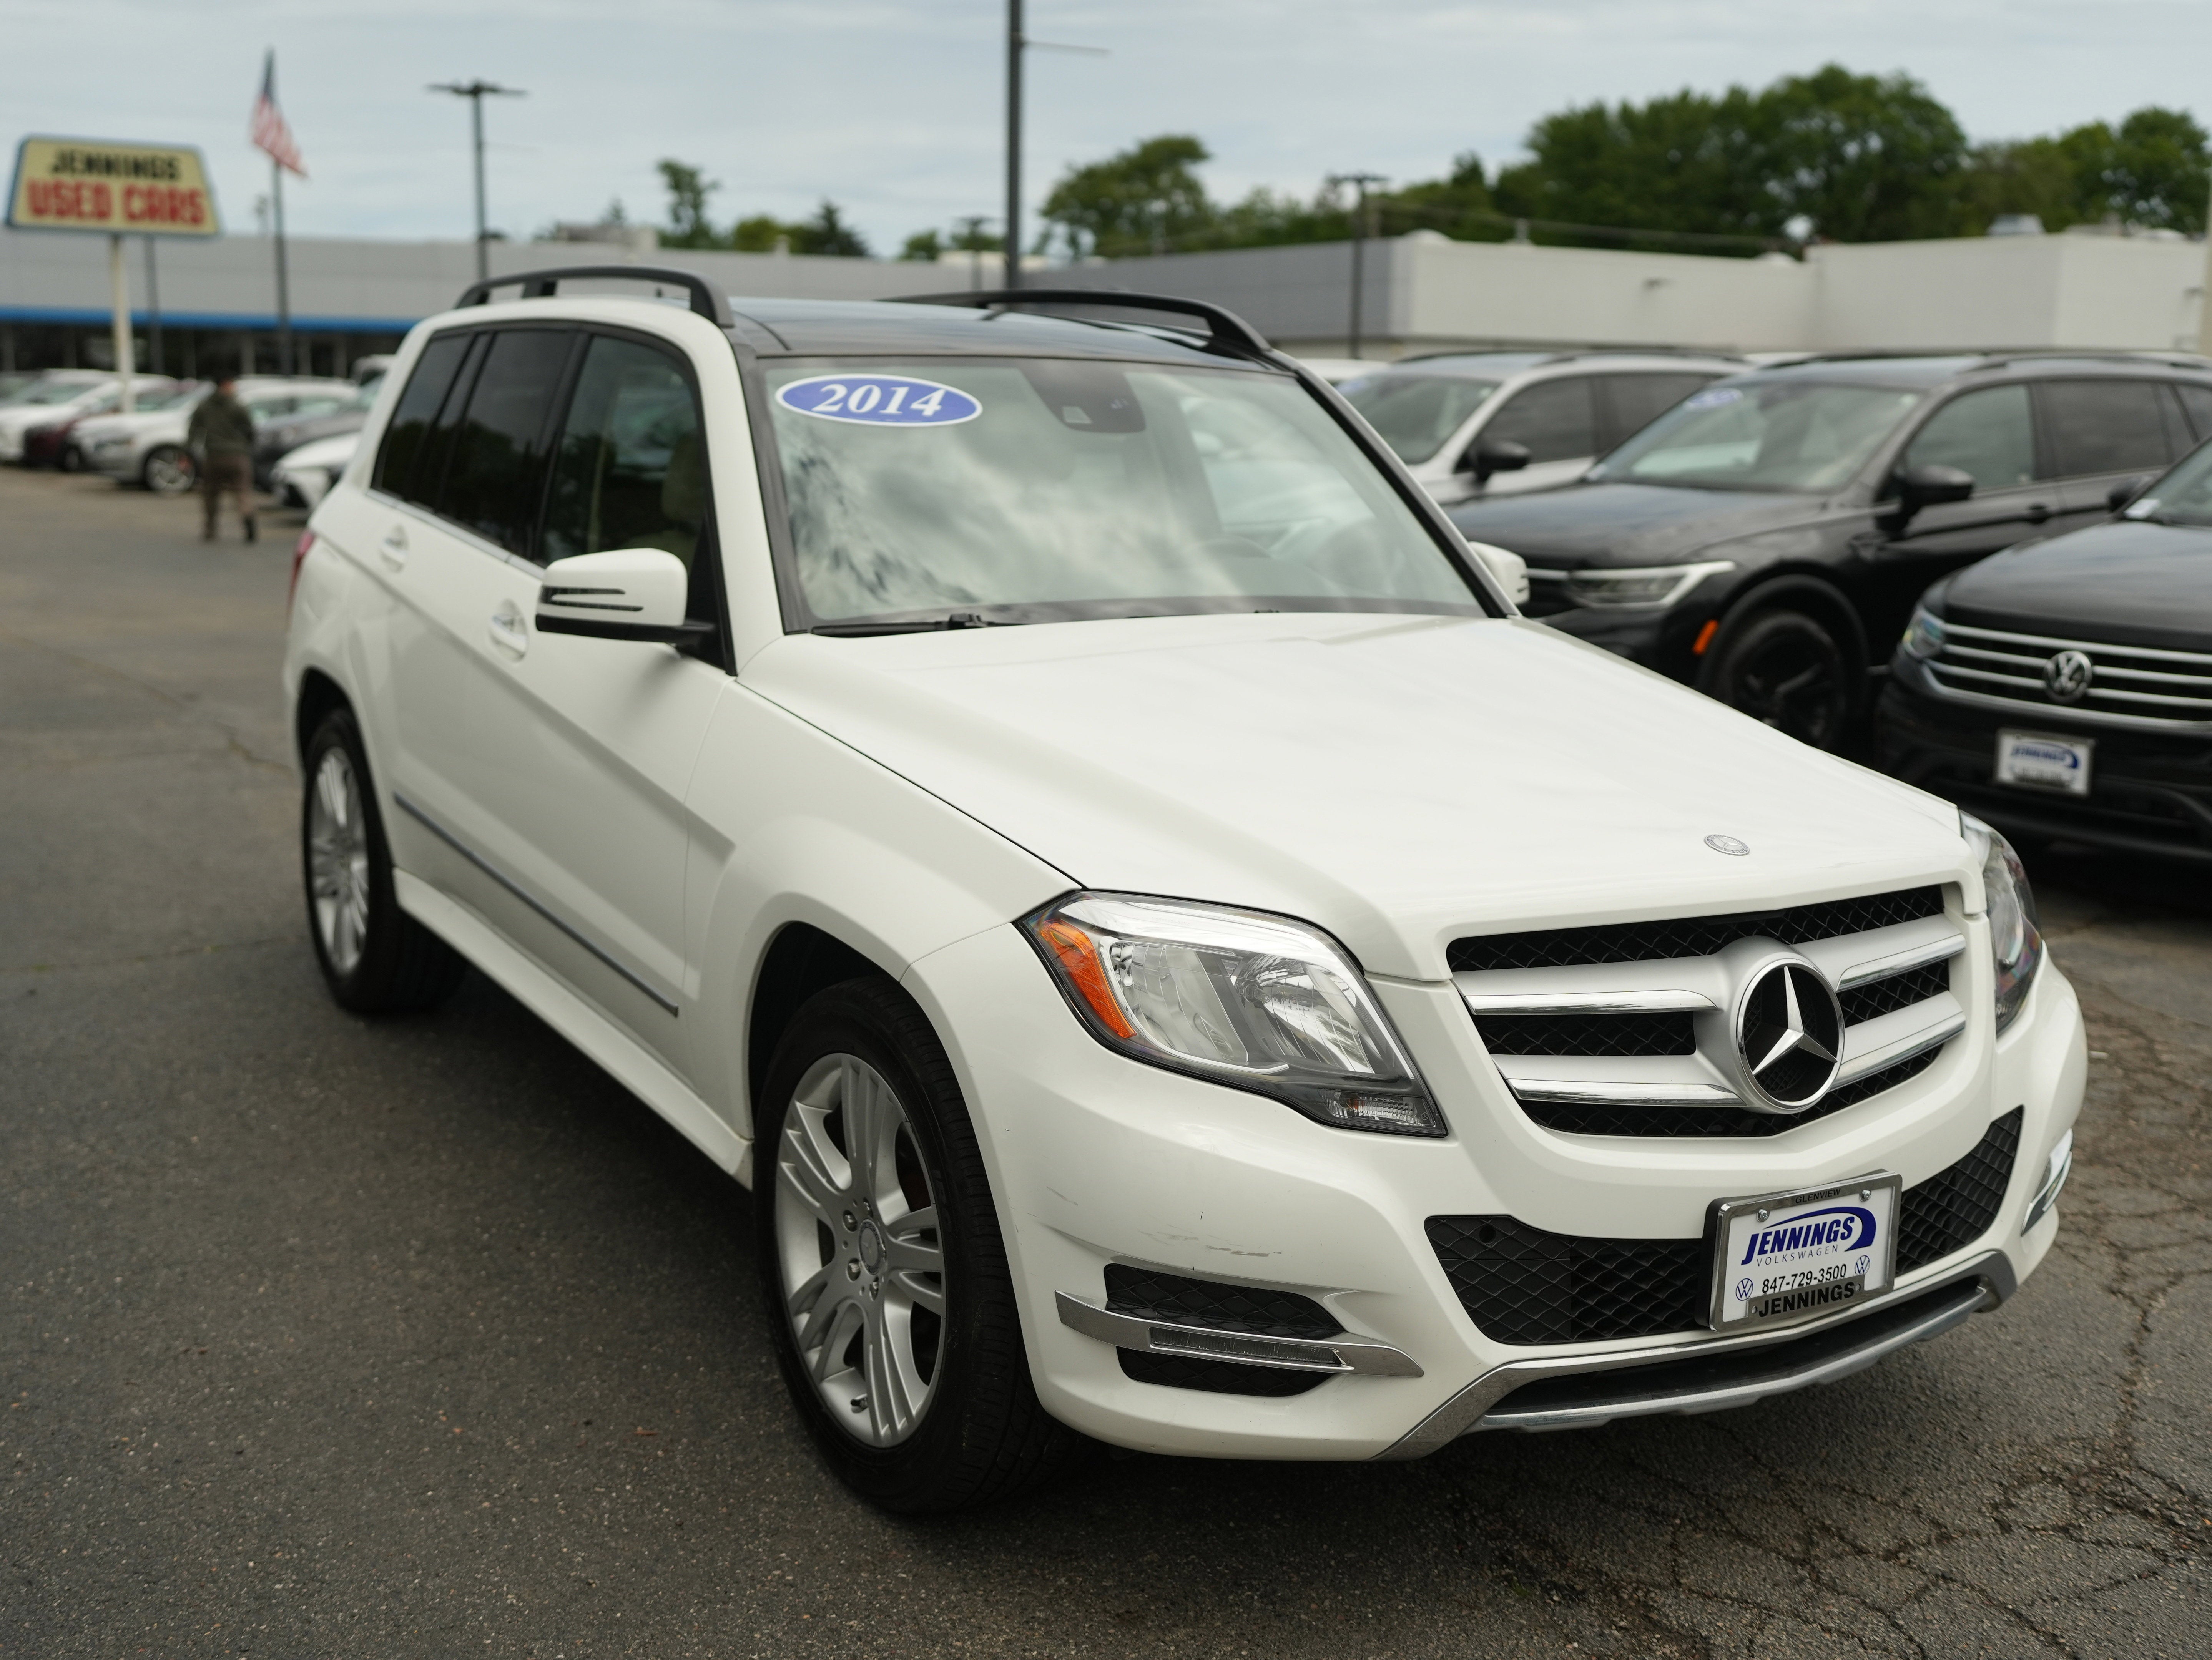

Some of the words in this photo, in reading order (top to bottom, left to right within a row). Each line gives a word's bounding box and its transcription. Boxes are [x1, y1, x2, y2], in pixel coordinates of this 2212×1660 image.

[52, 149, 178, 180] JENNINGS
[27, 178, 112, 220] USED
[123, 184, 206, 226] CARS
[811, 383, 947, 416] 2014
[1795, 1188, 1841, 1204] GLENVIEW
[1741, 1216, 1855, 1265] JENNINGS
[1757, 1244, 1838, 1267] VOLKSWAGEN
[1762, 1263, 1846, 1294] 847-729-3500
[1758, 1282, 1855, 1317] JENNINGS
